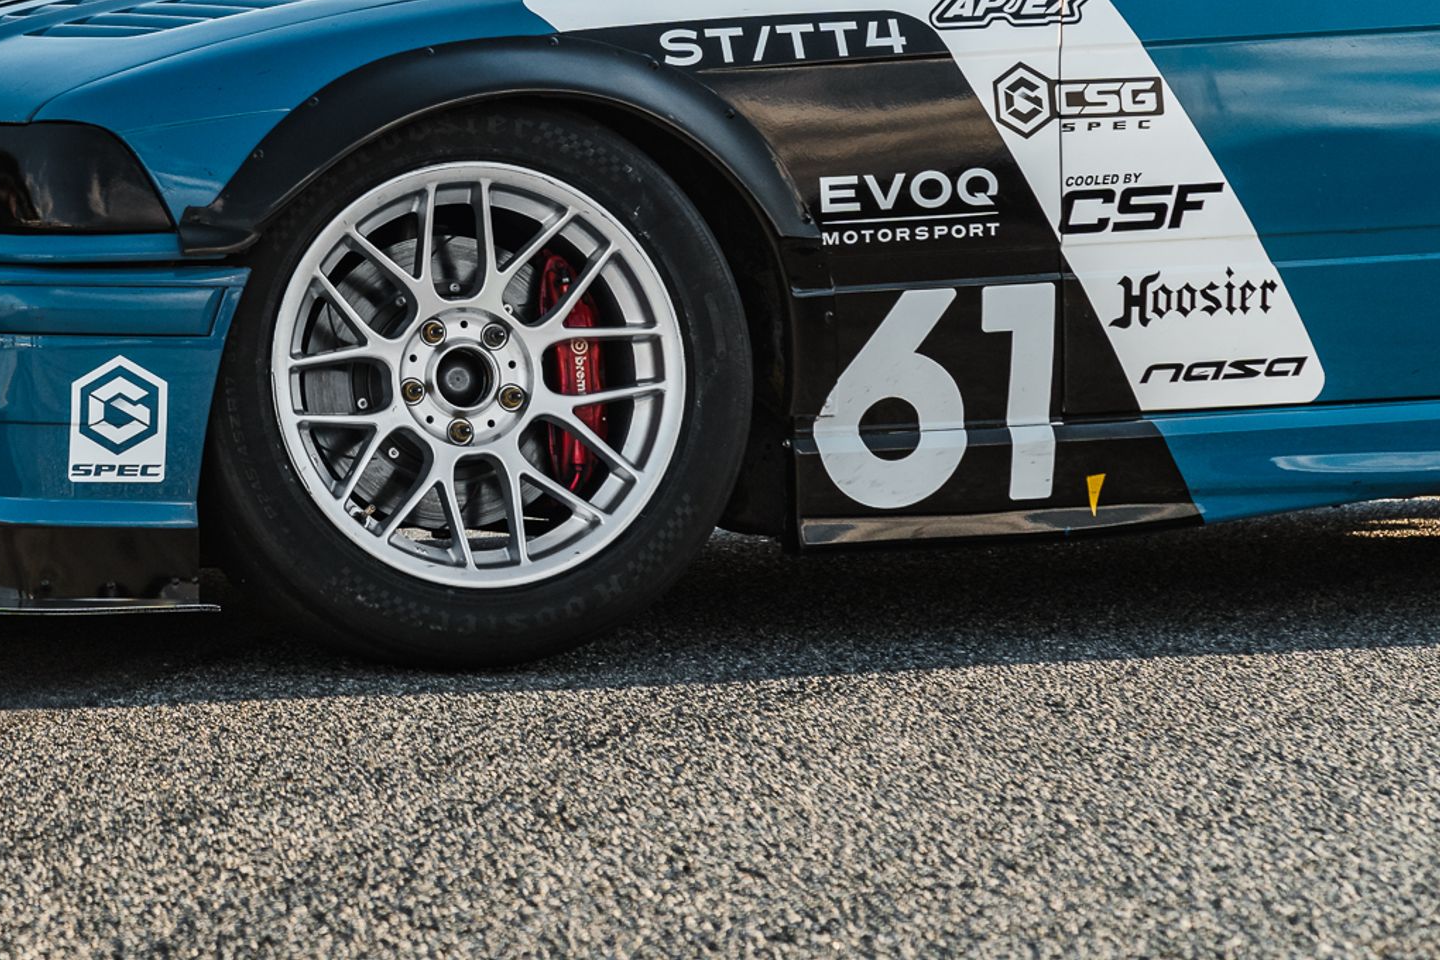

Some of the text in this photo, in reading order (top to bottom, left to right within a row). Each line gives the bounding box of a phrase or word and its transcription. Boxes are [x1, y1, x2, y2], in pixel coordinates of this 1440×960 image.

[659, 18, 908, 65] ST/TT4
[1054, 80, 1158, 115] CSG
[1061, 119, 1152, 133] SPEC
[819, 167, 999, 214] EVOQ
[1065, 172, 1143, 187] COOLED BY
[1059, 182, 1226, 235] CSF
[821, 222, 1001, 246] MOTORSPORT
[1108, 266, 1279, 329] Hoosier
[574, 356, 587, 395] brem
[1139, 356, 1308, 384] nasa
[813, 282, 1056, 510] 61
[71, 463, 162, 477] SPEC
